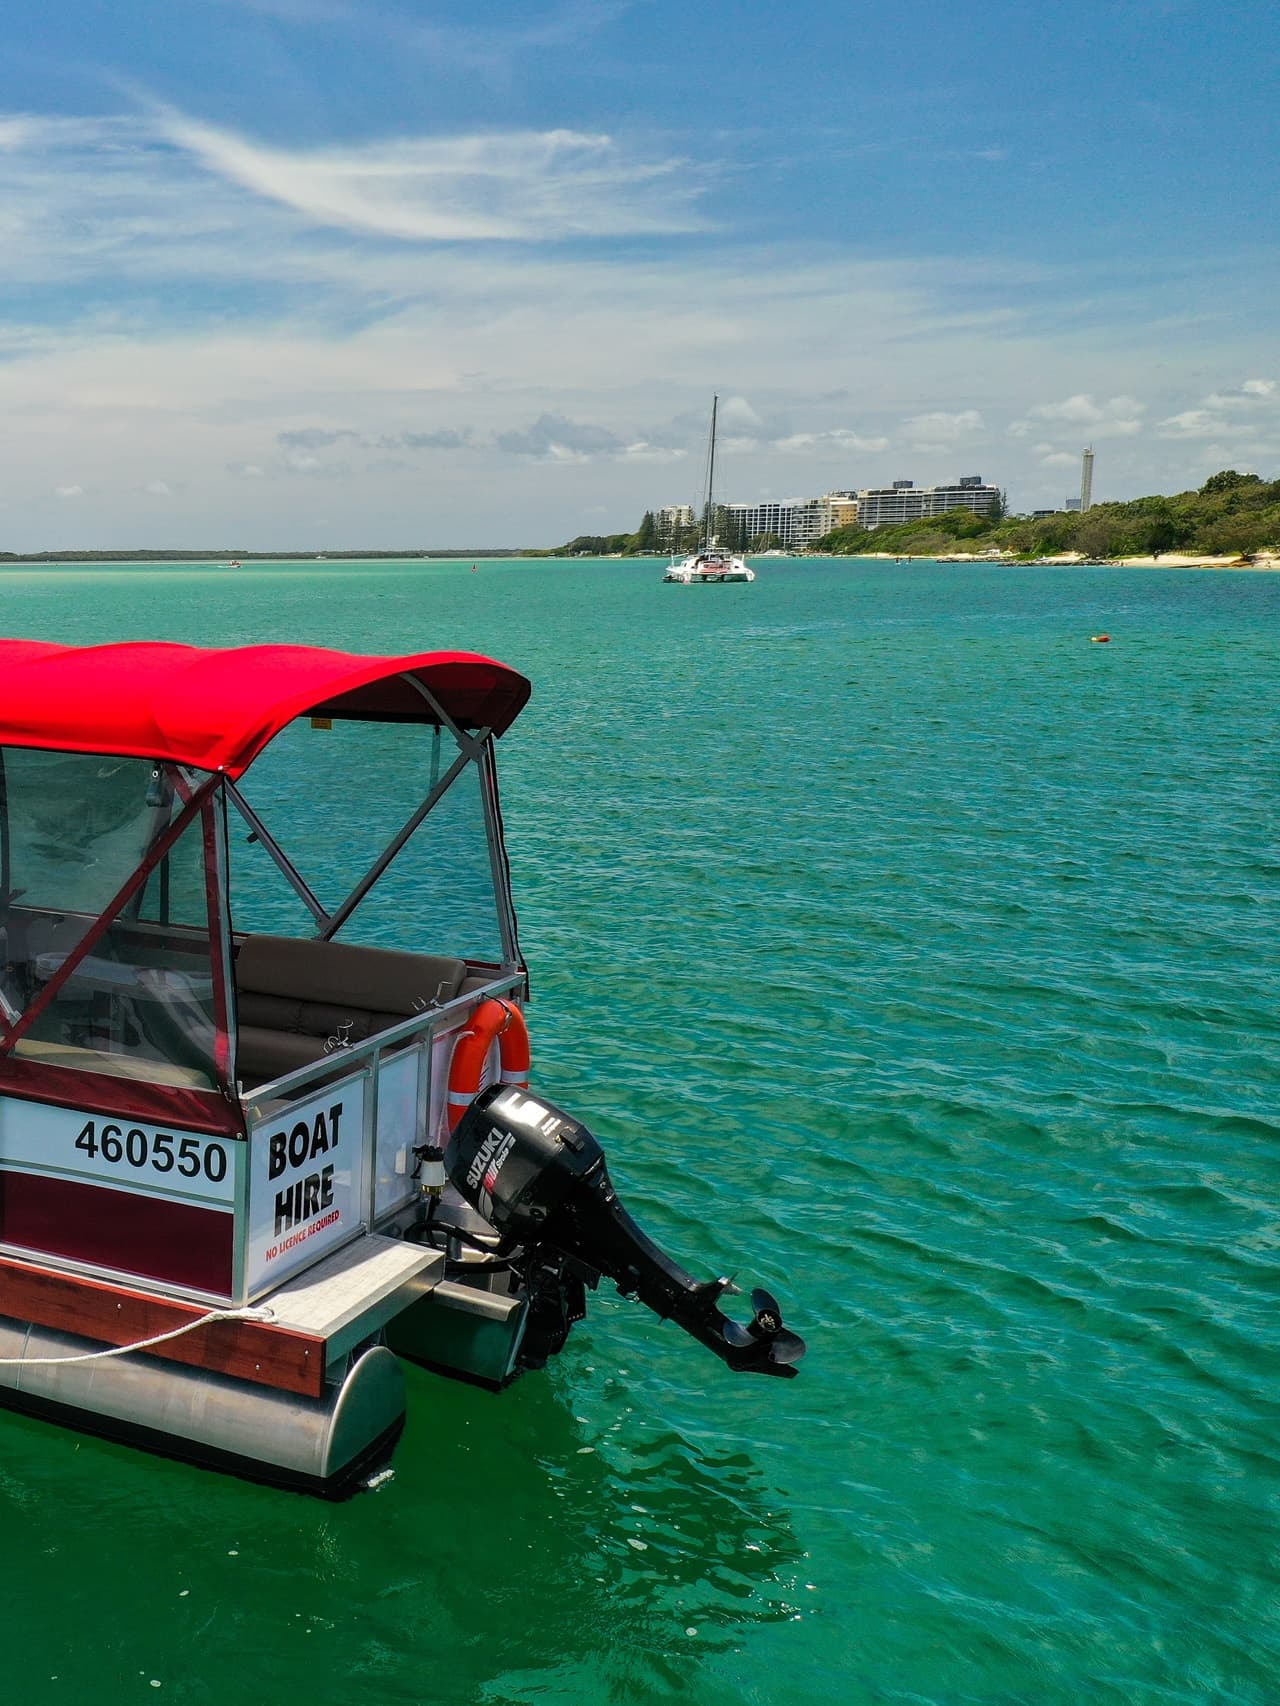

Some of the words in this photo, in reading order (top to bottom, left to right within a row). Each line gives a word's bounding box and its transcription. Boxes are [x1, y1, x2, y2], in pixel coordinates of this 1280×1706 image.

[74, 1121, 228, 1182] 460550
[268, 1102, 343, 1181] BOAT
[466, 1127, 504, 1189] SUZUKI
[273, 1163, 335, 1238] HIRE
[265, 1246, 278, 1262] NO
[279, 1229, 306, 1254] LICENCE
[307, 1209, 340, 1237] REQUIRED
